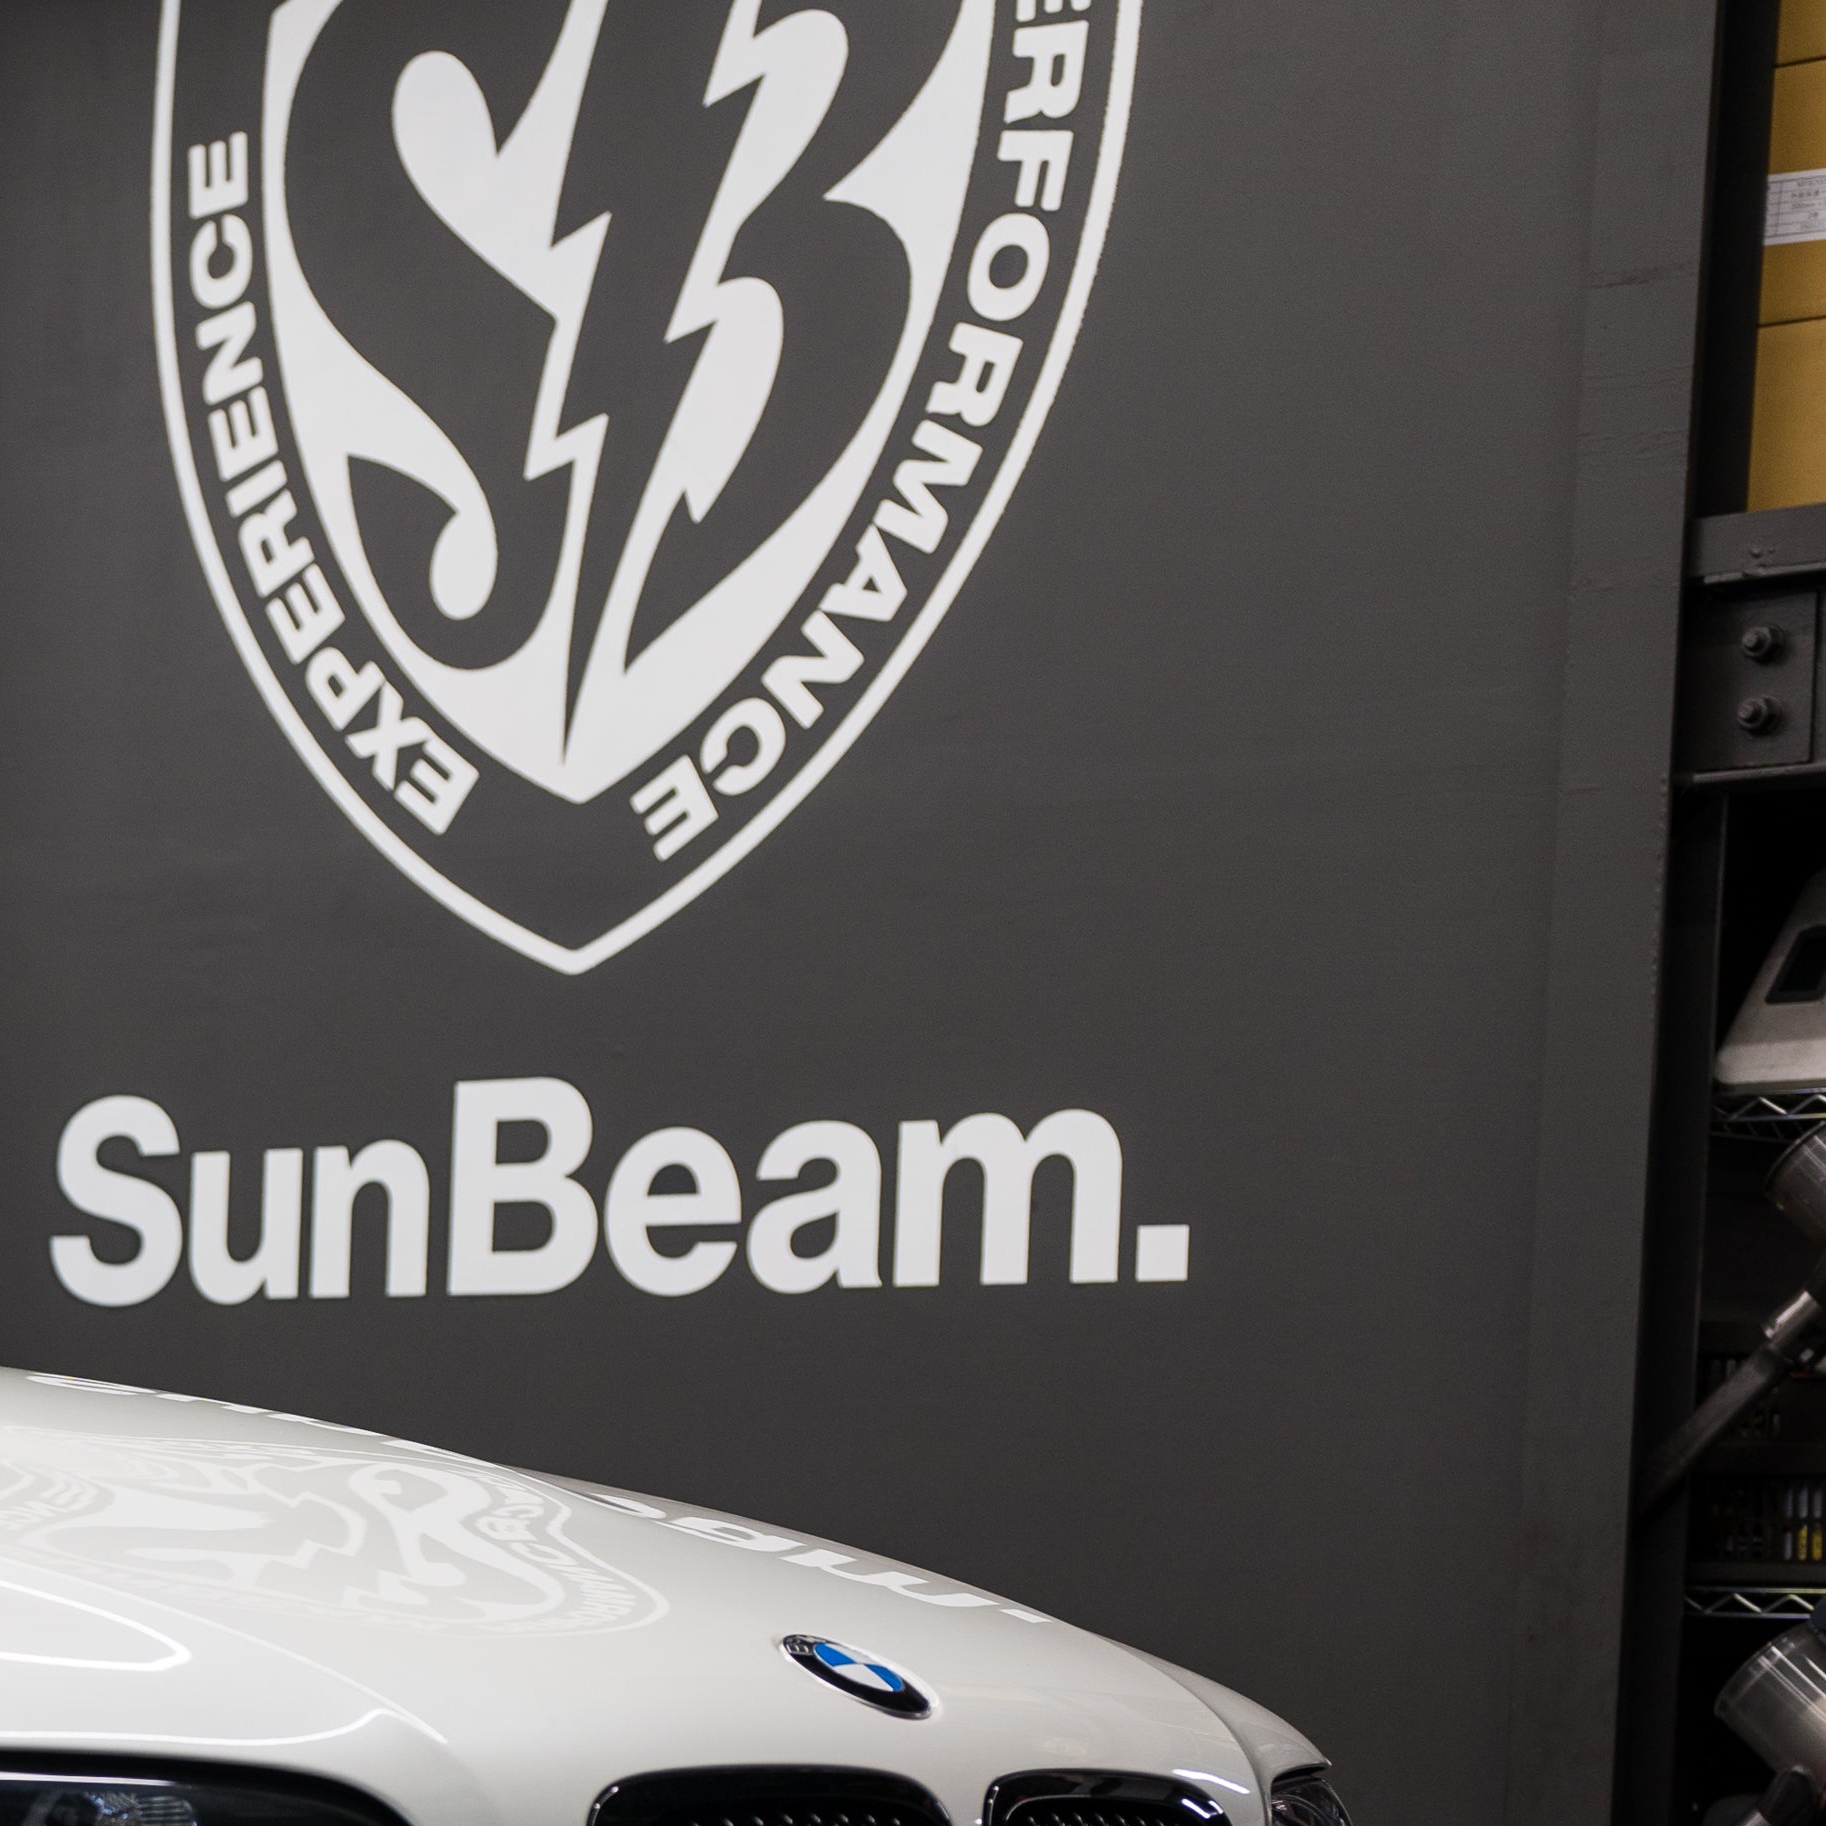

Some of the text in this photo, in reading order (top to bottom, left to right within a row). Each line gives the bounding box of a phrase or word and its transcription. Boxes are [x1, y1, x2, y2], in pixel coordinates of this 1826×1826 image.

[188, 131, 480, 835] EXPERIENCE
[631, 0, 1091, 861] RFORMANCE
[50, 1077, 1190, 1306] SunBeam.
